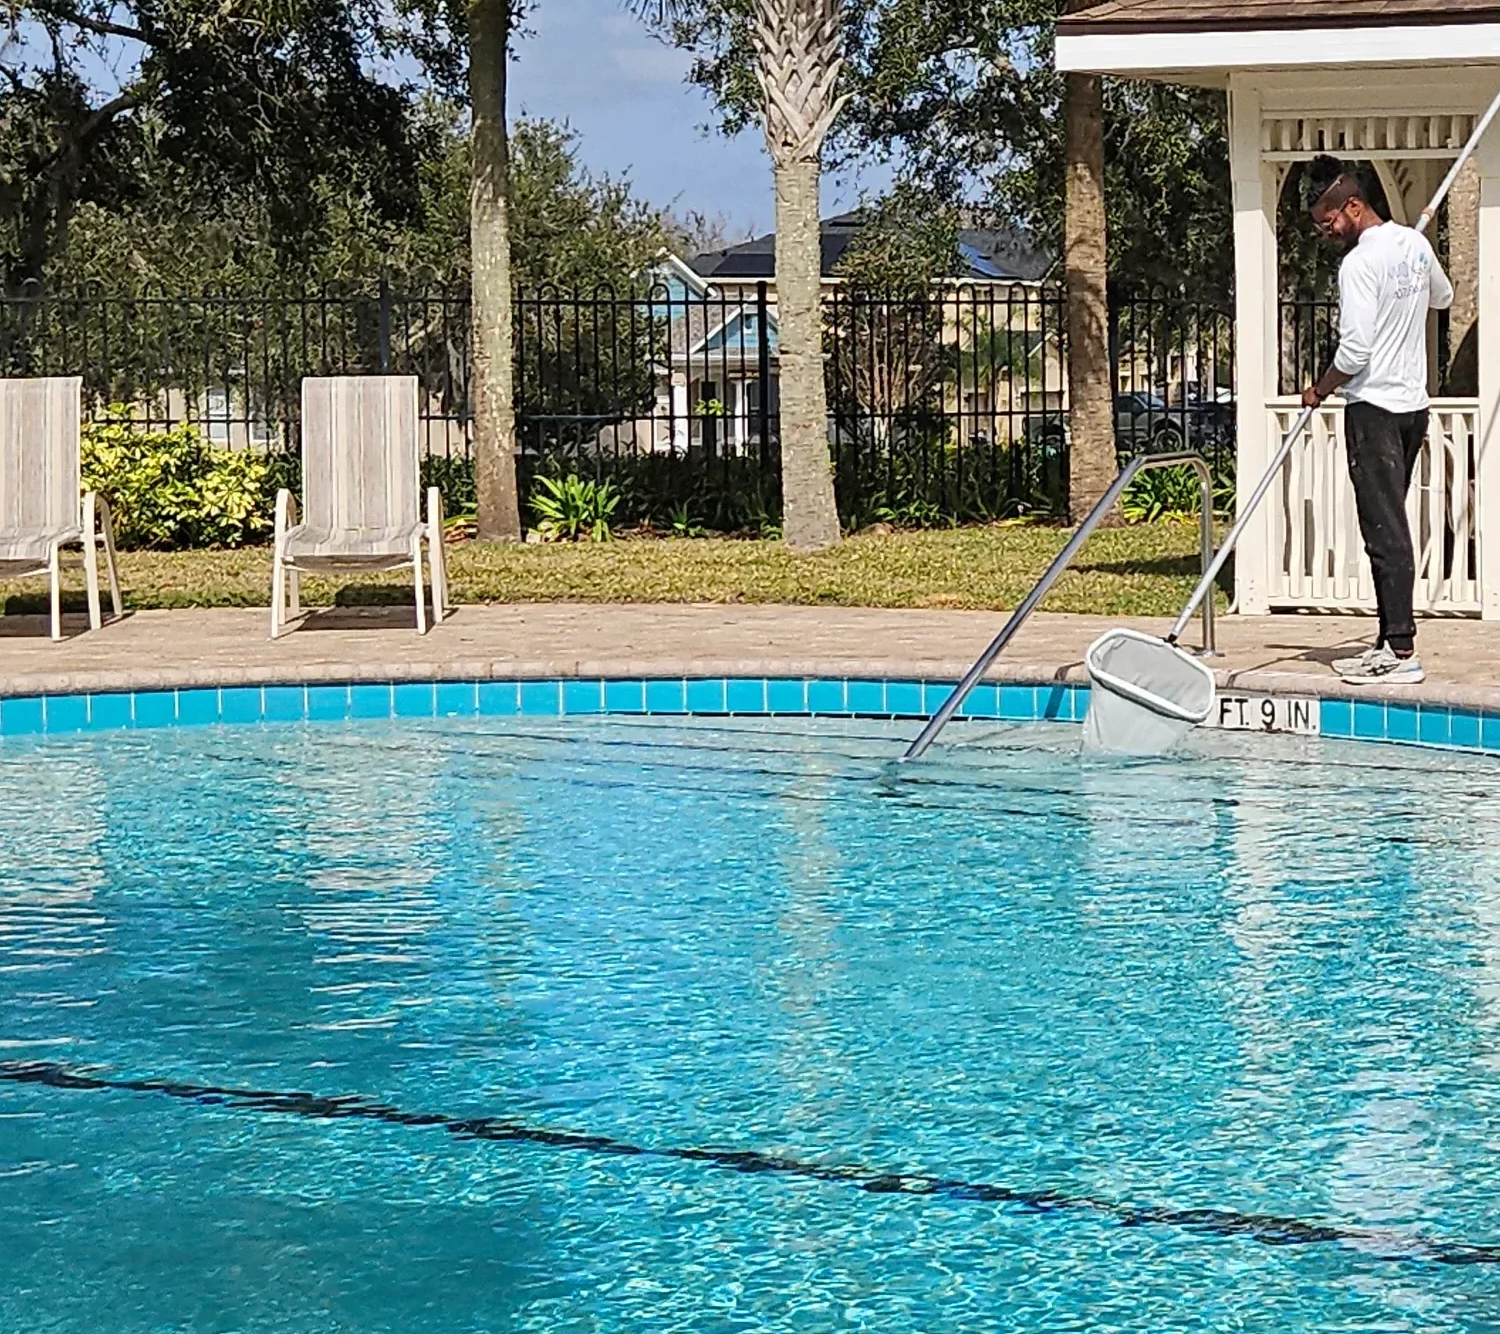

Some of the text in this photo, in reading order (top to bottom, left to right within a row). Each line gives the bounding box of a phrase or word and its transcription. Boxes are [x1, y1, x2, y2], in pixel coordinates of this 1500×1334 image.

[1220, 698, 1317, 730] FT. 9 IN.
